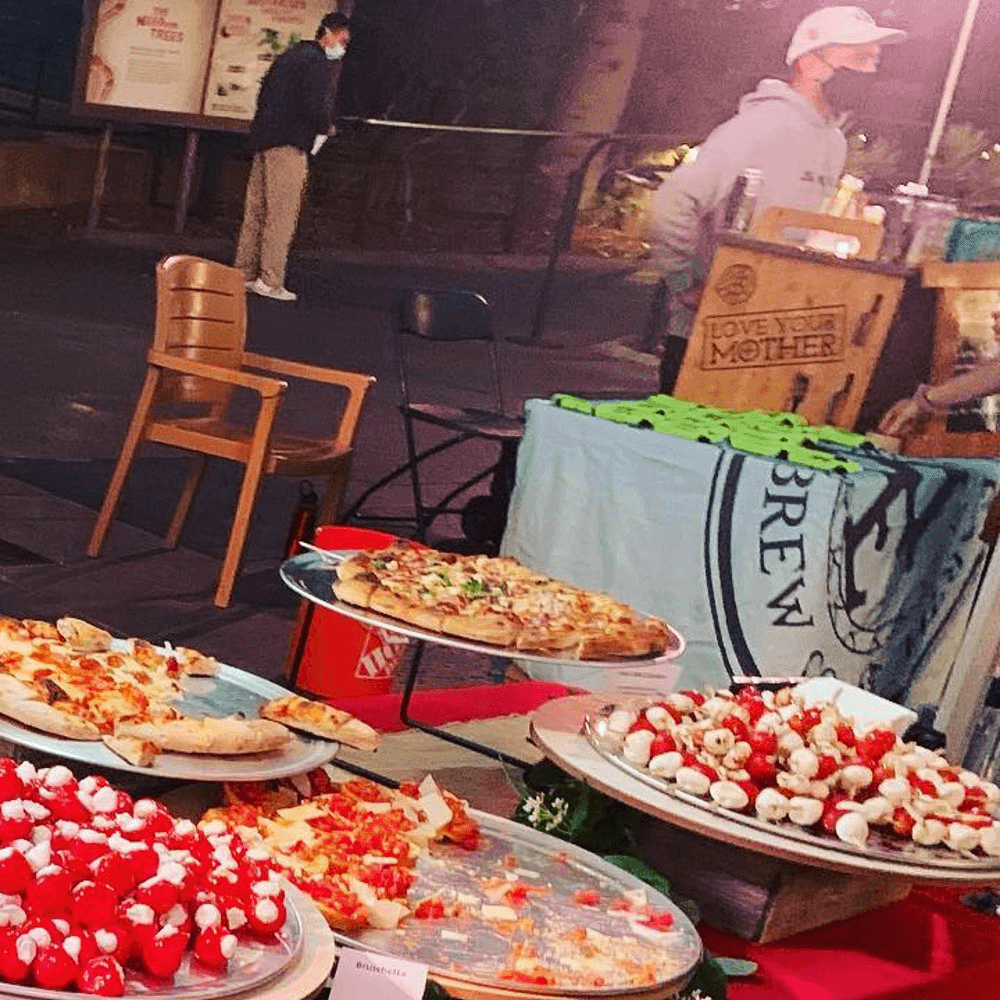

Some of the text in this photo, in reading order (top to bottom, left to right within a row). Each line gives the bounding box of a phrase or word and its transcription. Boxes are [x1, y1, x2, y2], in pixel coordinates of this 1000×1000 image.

[711, 318, 767, 339] LOVE
[710, 333, 836, 364] MOTHER
[759, 463, 815, 627] BREW
